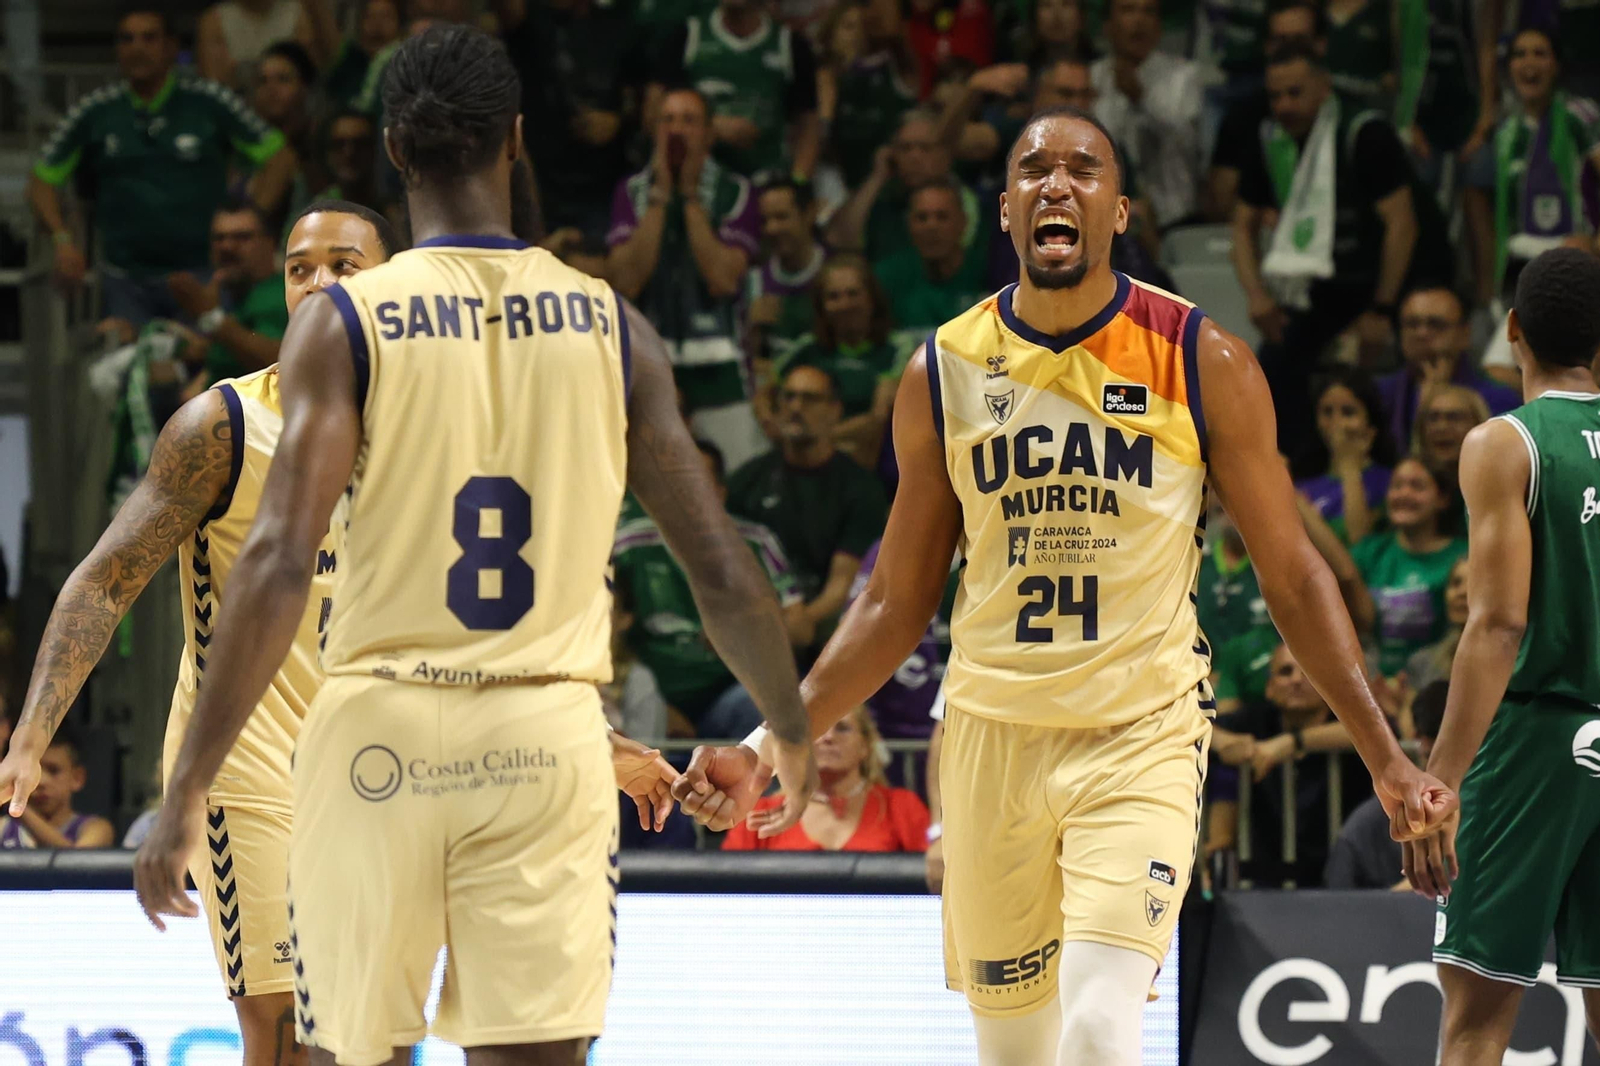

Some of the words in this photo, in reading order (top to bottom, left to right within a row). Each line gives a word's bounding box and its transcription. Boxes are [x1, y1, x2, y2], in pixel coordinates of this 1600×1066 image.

[1106, 392, 1125, 403] liga
[1105, 402, 1145, 412] endesa
[972, 422, 1154, 494] UCAM
[1000, 484, 1120, 521] MURCIA
[1034, 526, 1092, 537] CARAVACA
[1034, 540, 1047, 550] DE
[1049, 540, 1062, 549] LA
[1064, 539, 1090, 549] CRUZ
[1092, 538, 1117, 549] 2024
[446, 476, 534, 631] 8
[1034, 552, 1056, 564] AÑO
[1058, 553, 1096, 565] JUBILAR
[1015, 575, 1098, 643] 24
[408, 758, 475, 780] Costa
[482, 747, 558, 772] Cálida
[468, 777, 486, 790] de
[1151, 868, 1171, 883] acb
[982, 938, 1060, 986] ESP
[970, 973, 1047, 995] SOLUTIONS
